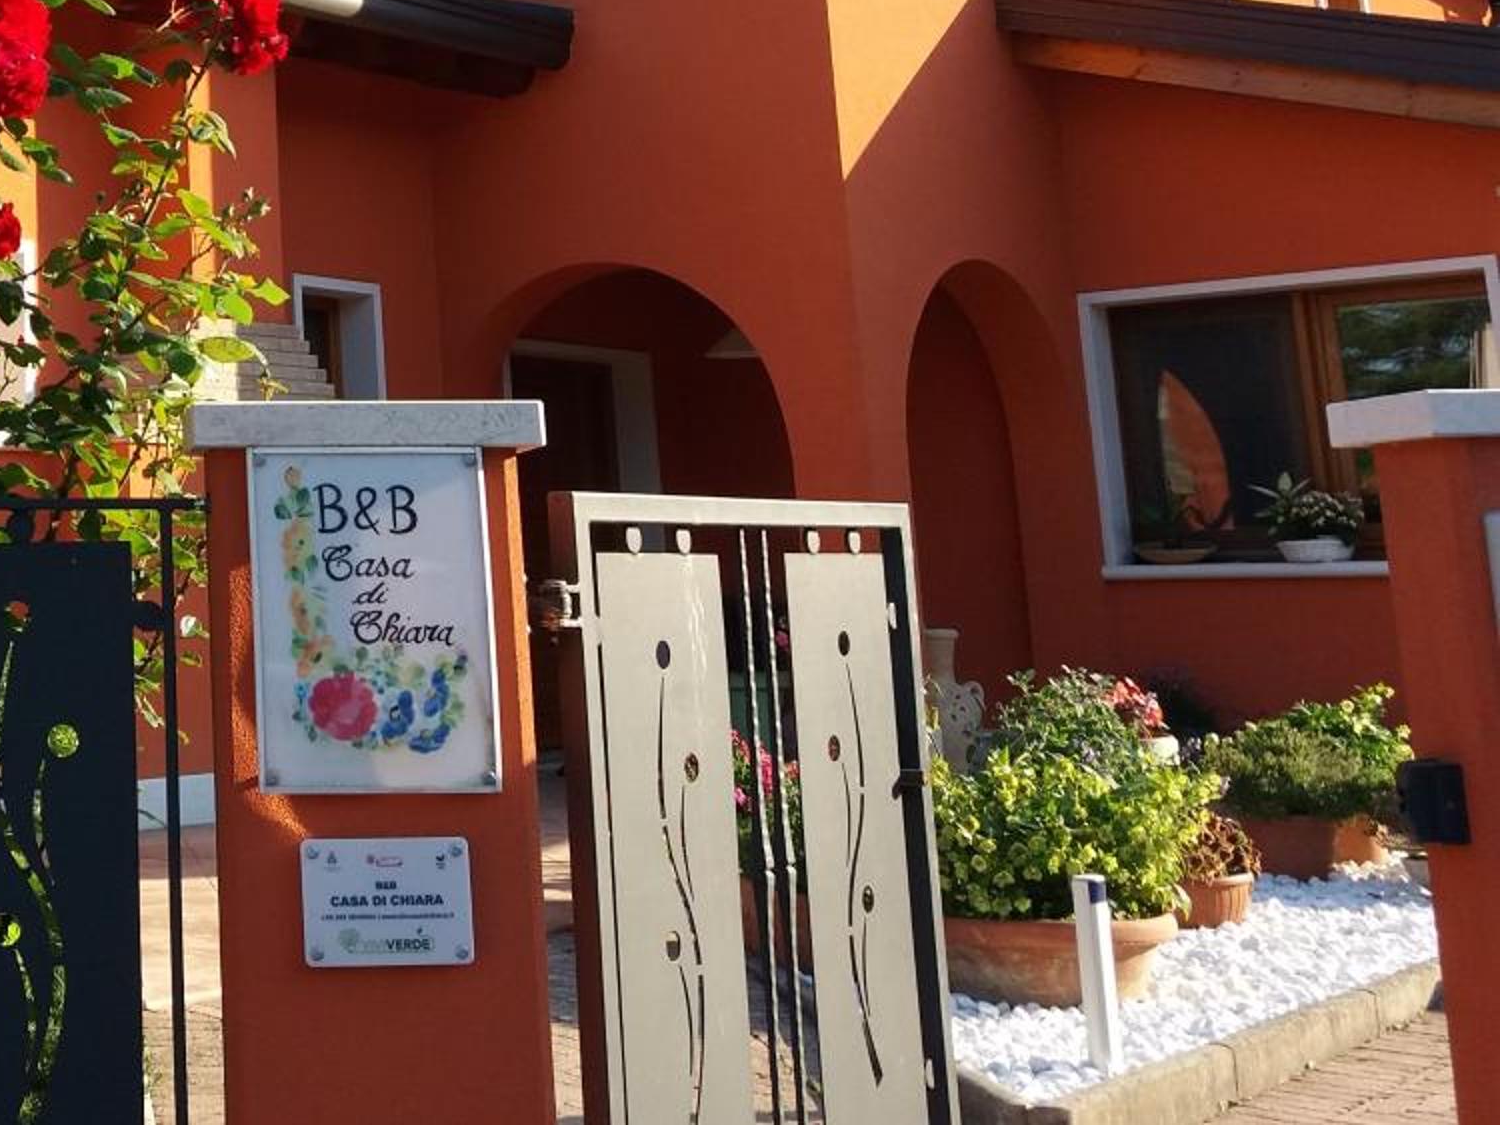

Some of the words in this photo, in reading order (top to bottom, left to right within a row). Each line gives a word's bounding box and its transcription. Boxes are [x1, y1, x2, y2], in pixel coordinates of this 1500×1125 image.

[313, 483, 418, 535] B&B
[322, 544, 415, 582] Casa
[352, 582, 389, 605] di
[350, 610, 455, 646] Chiara
[330, 896, 369, 907] CASA
[372, 896, 387, 906] DI
[390, 894, 444, 906] CHIARA
